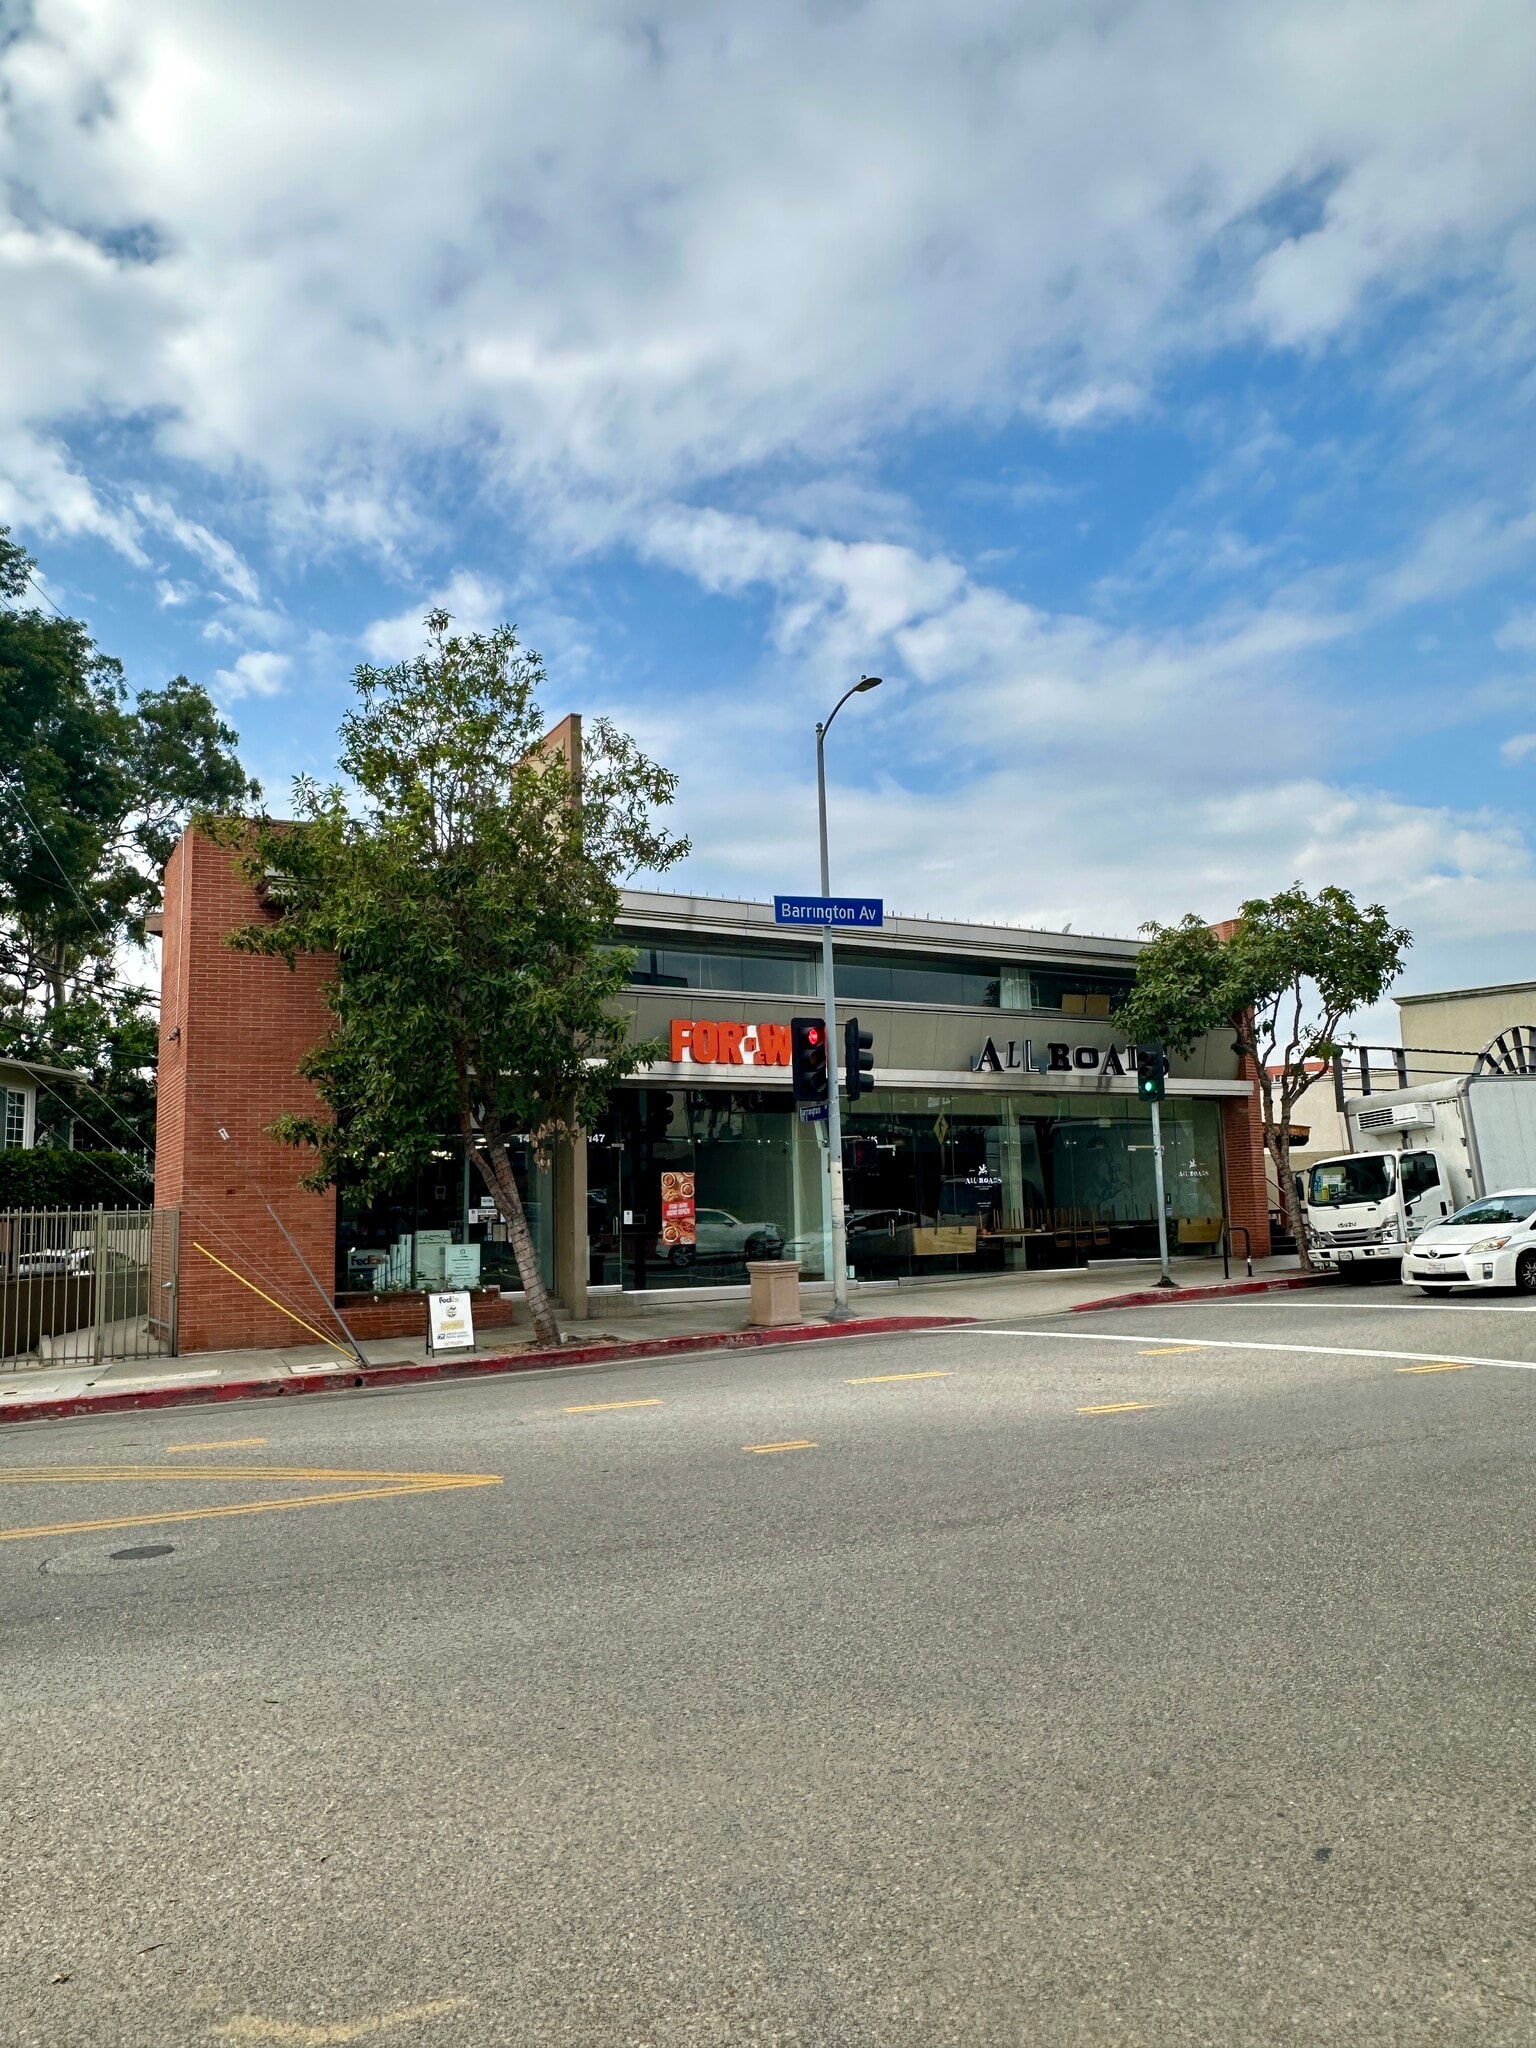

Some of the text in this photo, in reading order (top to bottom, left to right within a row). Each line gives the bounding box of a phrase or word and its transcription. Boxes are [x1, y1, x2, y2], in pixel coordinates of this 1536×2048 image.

[781, 903, 876, 923] Barrington Av
[671, 1019, 743, 1064] FOR
[973, 1036, 1170, 1076] ALL ROA
